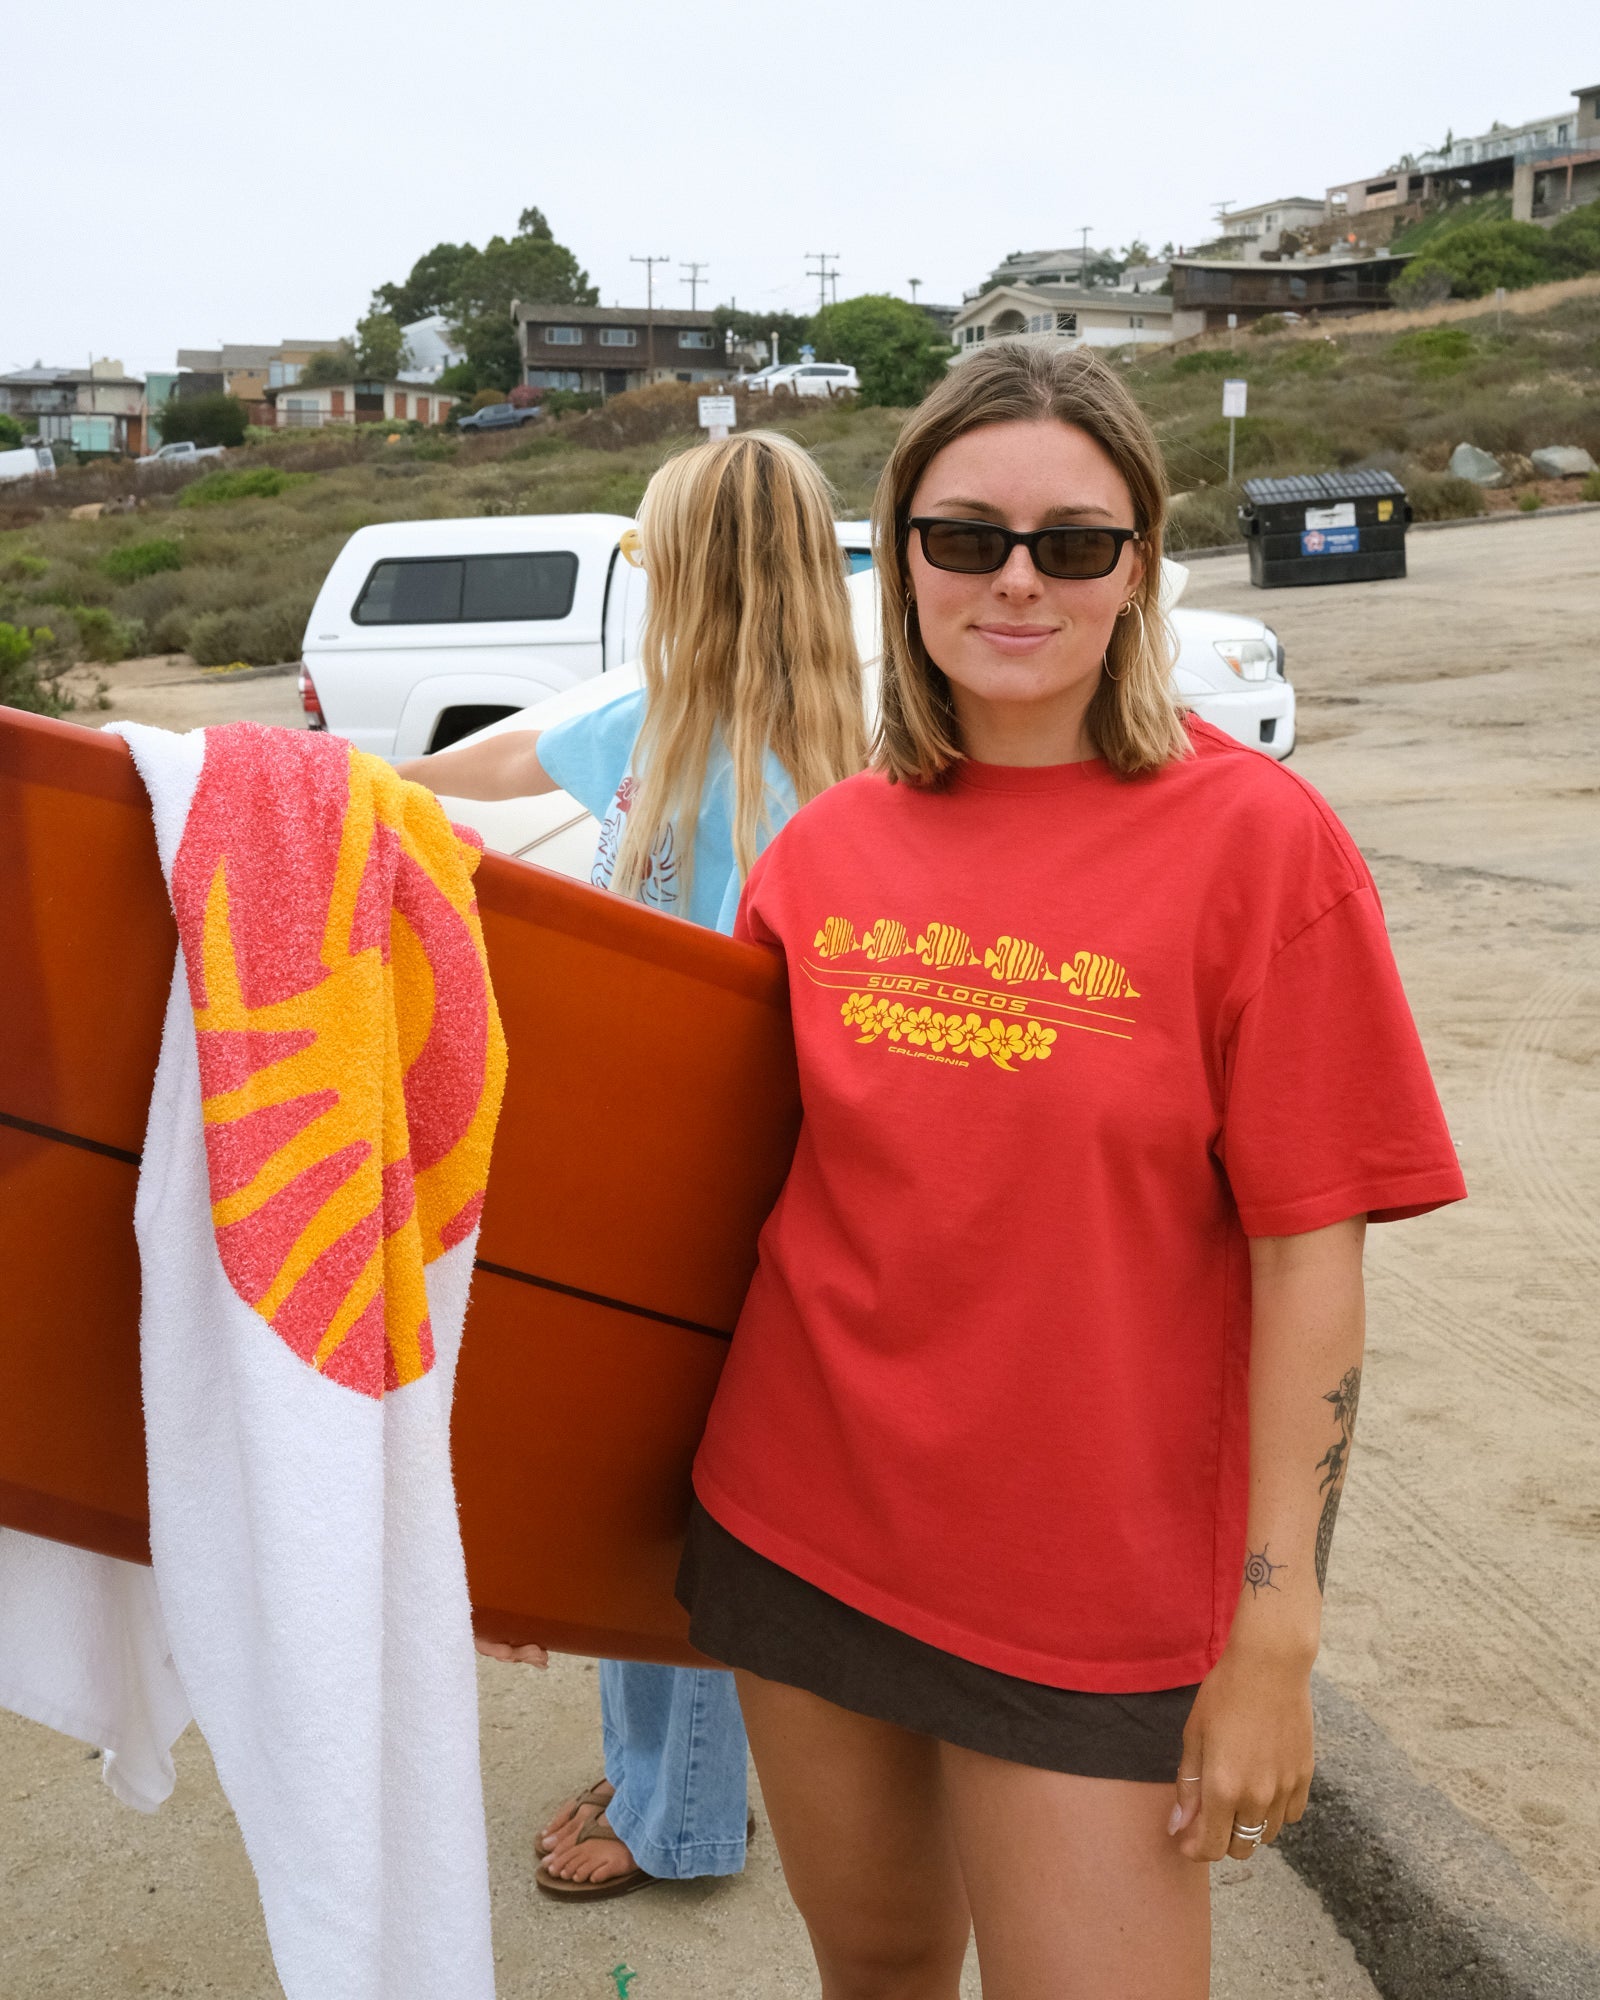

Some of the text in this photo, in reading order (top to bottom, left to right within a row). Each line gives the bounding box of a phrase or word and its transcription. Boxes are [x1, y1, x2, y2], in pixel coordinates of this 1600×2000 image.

[867, 976, 1028, 1012] SURF LOCOS
[888, 1046, 969, 1067] CALIFORNIA
